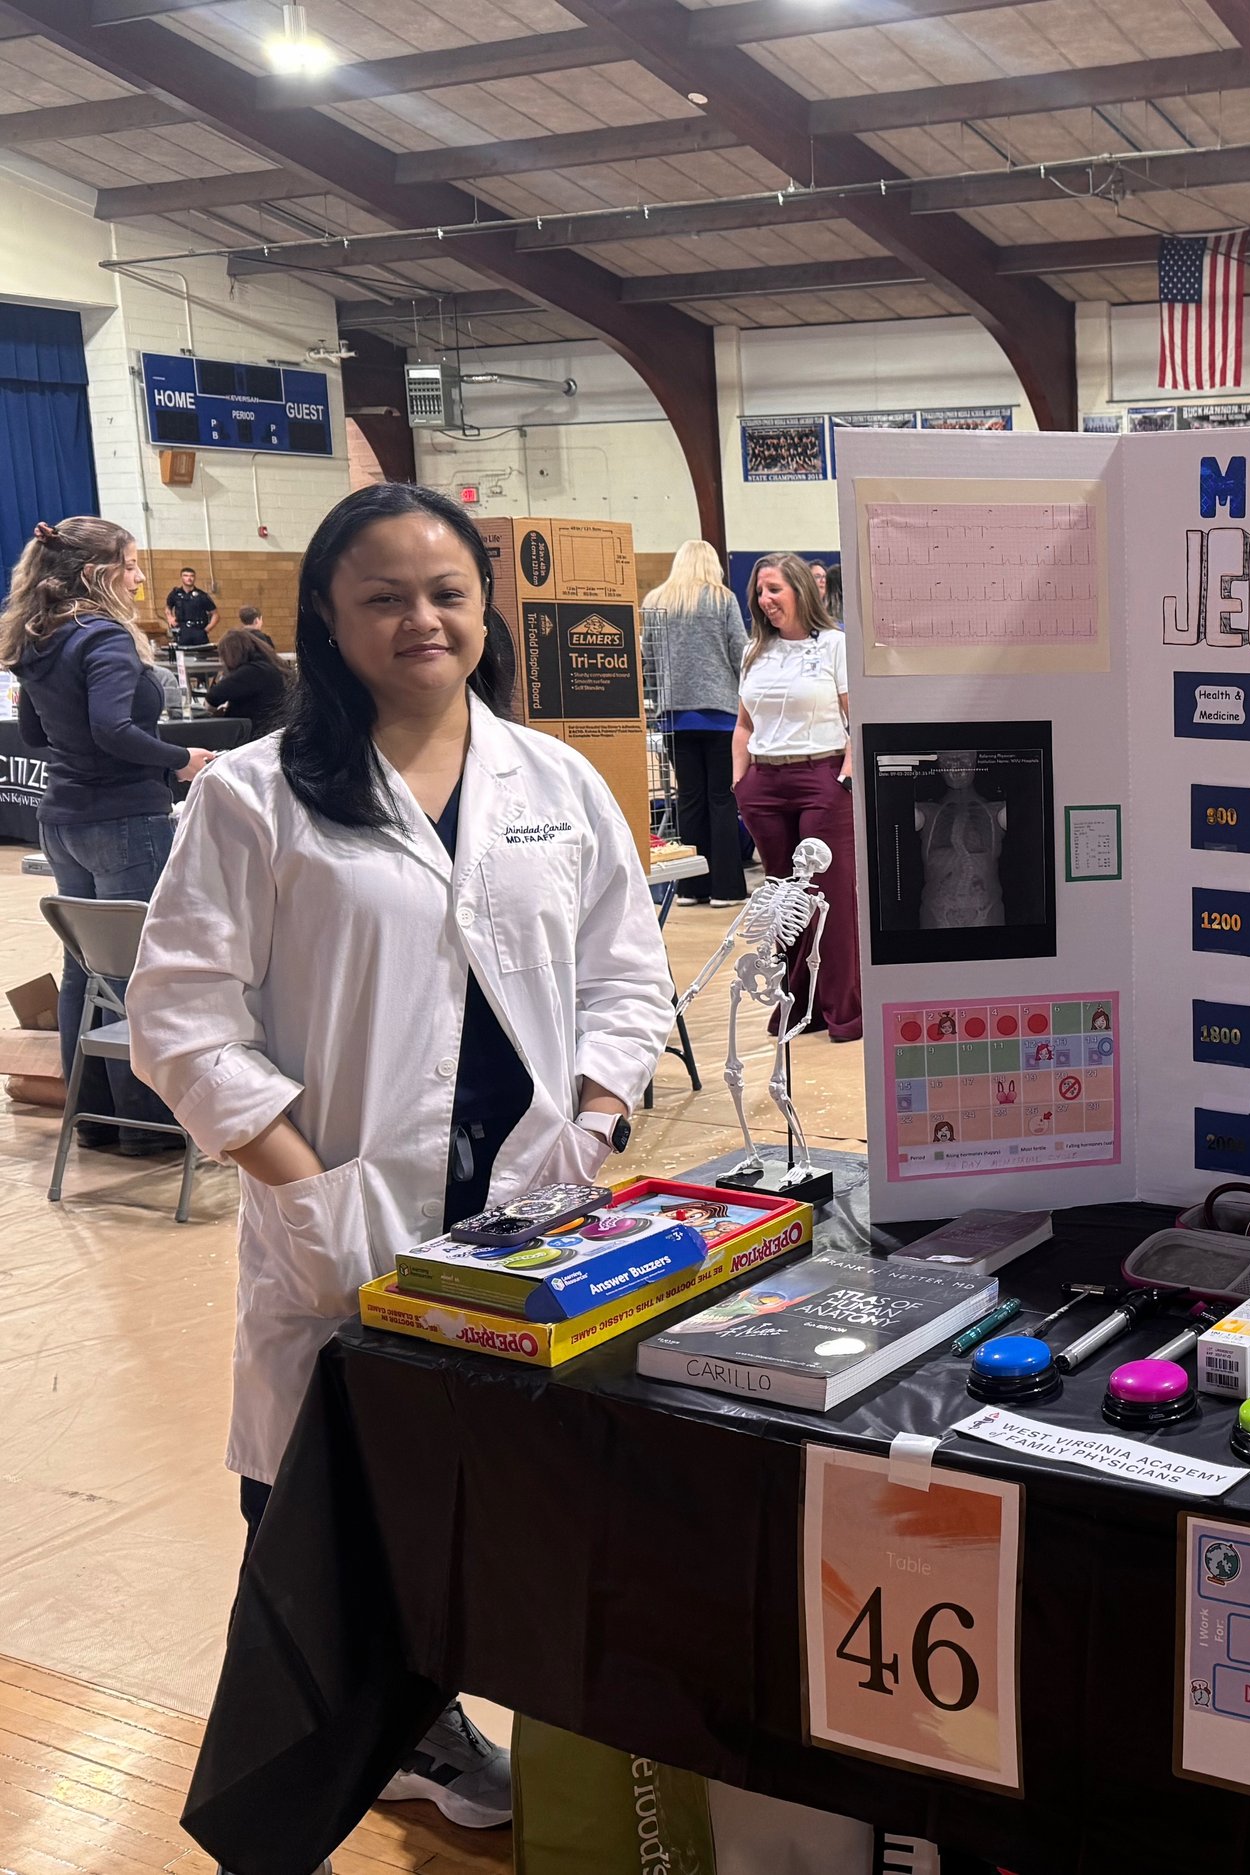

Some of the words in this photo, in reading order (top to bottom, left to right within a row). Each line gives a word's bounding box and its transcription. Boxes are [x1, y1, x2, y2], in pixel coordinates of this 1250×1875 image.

[155, 389, 196, 409] HOME
[232, 410, 254, 420] PERIOD
[286, 402, 324, 420] GUEST
[211, 419, 216, 427] P
[270, 424, 276, 432] P
[212, 431, 219, 439] B
[272, 436, 278, 444] B
[528, 613, 538, 647] Tri-Fold
[573, 635, 620, 645] ELMER'S
[529, 648, 538, 681] Display
[569, 653, 628, 669] Tri-Fold
[532, 682, 542, 709] Board
[1199, 689, 1231, 700] Health
[1235, 690, 1242, 701] &
[1199, 711, 1240, 722] Medicine
[1206, 807, 1238, 826] 800
[1200, 911, 1241, 932] 1200
[1199, 1025, 1241, 1045] 1800
[729, 1221, 803, 1274] OPERATION
[562, 1271, 582, 1281] Learning
[590, 1272, 630, 1295] Answer
[628, 1256, 672, 1276] Buzzers
[698, 1269, 712, 1283] THE
[712, 1264, 723, 1276] BE
[665, 1277, 695, 1300] DOCTOR
[952, 1282, 975, 1290] MD
[636, 1299, 654, 1313] THIS
[655, 1294, 665, 1305] IN
[821, 1298, 903, 1318] HUMAN
[827, 1290, 890, 1305] ATLAS
[891, 1301, 923, 1310] OF
[599, 1308, 634, 1330] CLASSIC
[794, 1305, 900, 1327] ANATOMY
[570, 1327, 598, 1345] GAME!
[687, 1360, 771, 1391] CARILLO
[989, 1431, 1007, 1440] of
[1006, 1434, 1069, 1456] FAMILY
[1068, 1449, 1182, 1483] PHYSICIANS
[1002, 1422, 1051, 1441] WEST
[1057, 1437, 1131, 1460] VIRGINIA
[1139, 1457, 1227, 1483] ACADEMY
[886, 1551, 932, 1575] Table
[1199, 1608, 1209, 1638] Work
[1214, 1620, 1224, 1642] For:
[836, 1586, 980, 1712] 46
